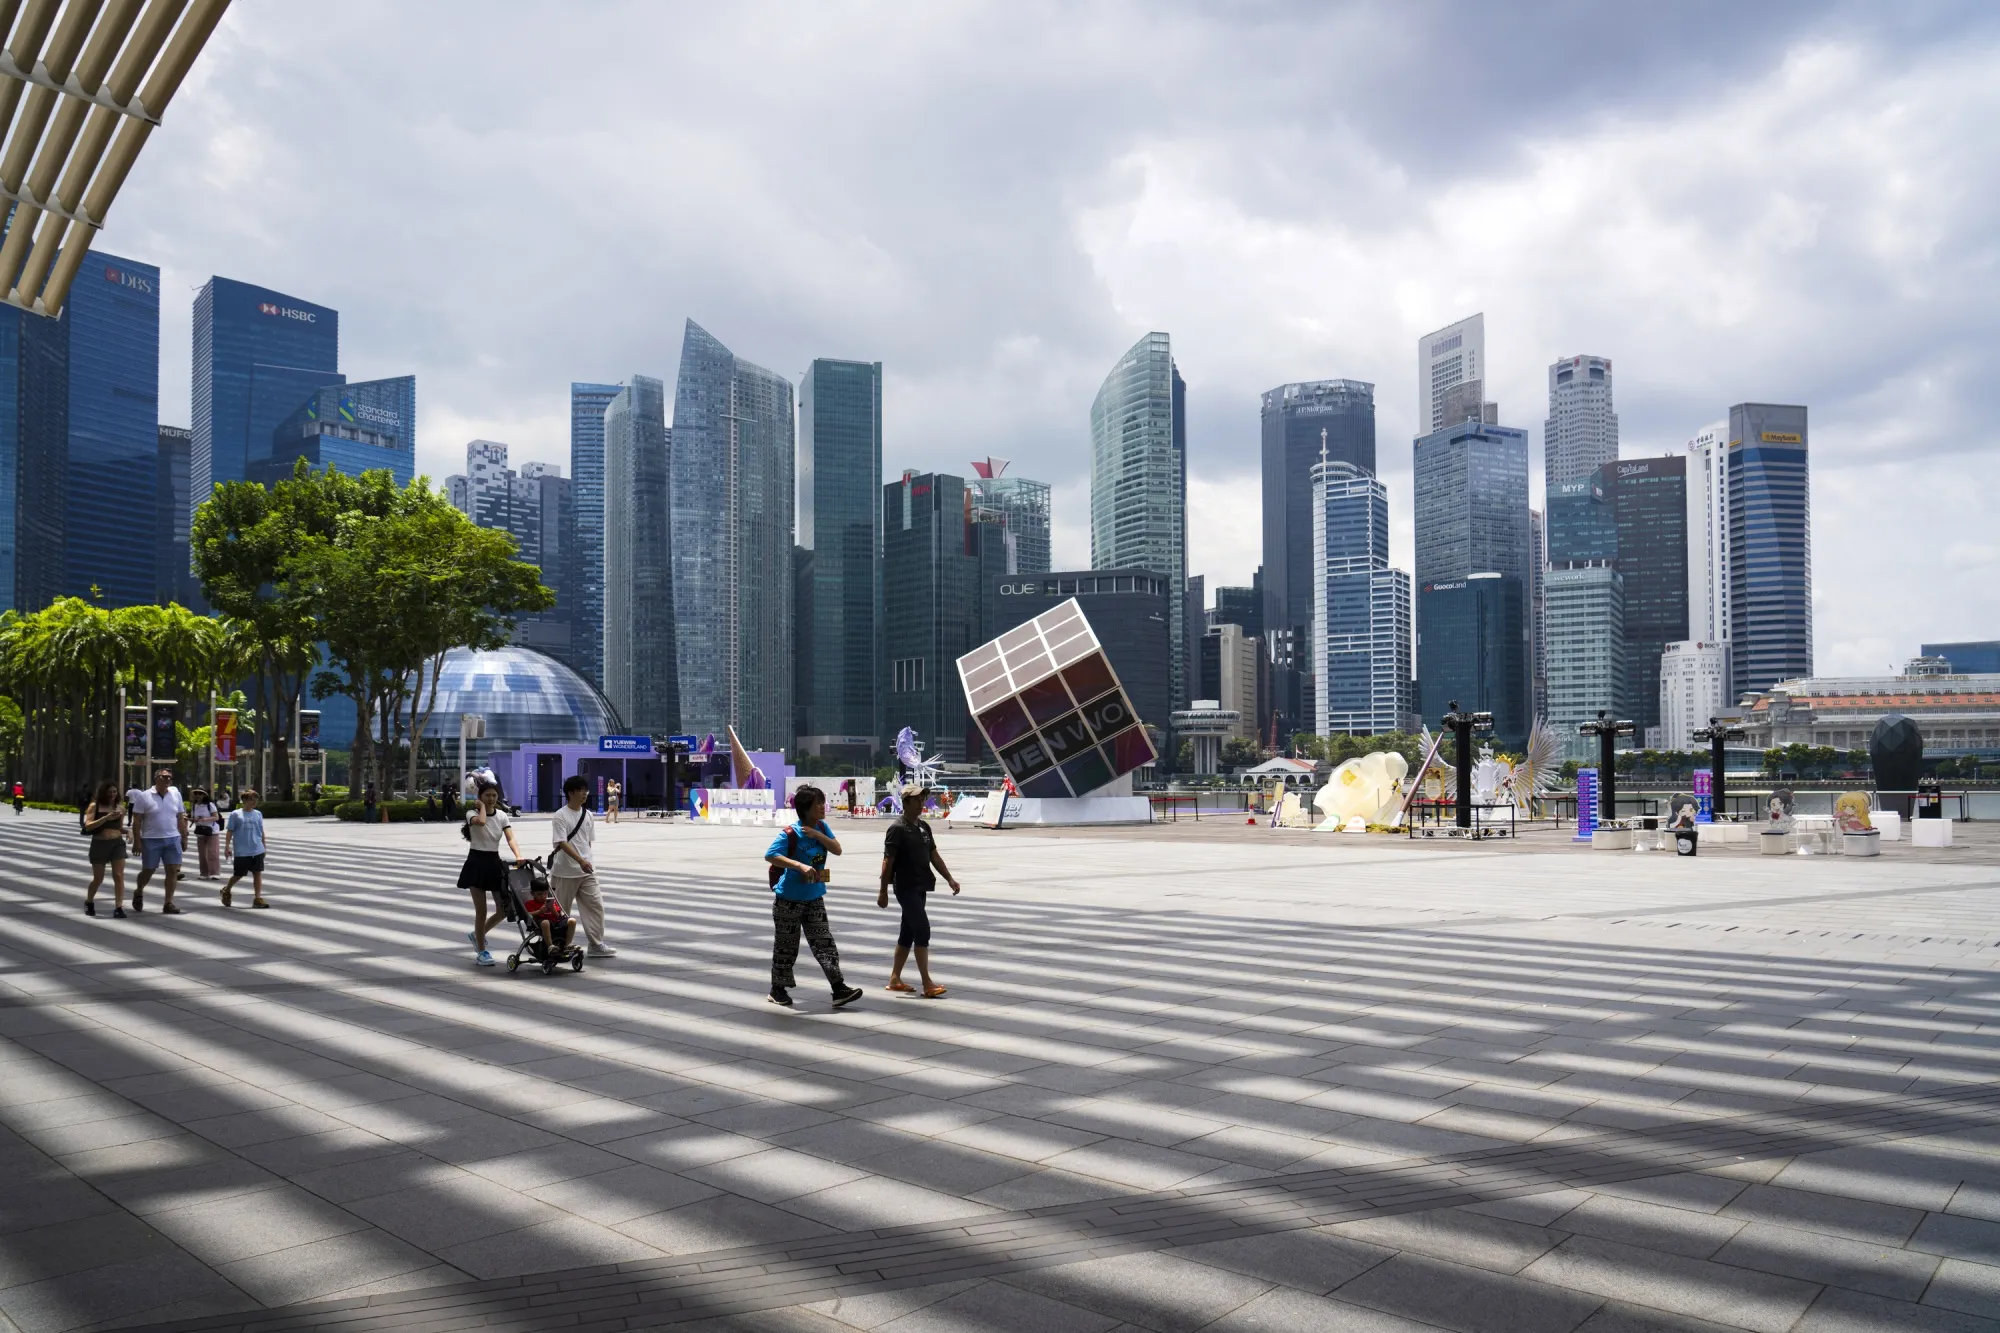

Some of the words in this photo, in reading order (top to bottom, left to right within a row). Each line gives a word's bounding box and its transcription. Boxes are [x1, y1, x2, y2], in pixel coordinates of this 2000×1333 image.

[121, 272, 152, 293] DBS
[281, 308, 317, 323] HSBC
[357, 403, 398, 419] standard
[357, 410, 400, 427] chartered
[159, 427, 192, 440] MUFG
[1770, 433, 1799, 443] Maybank
[482, 448, 503, 461] citi
[1617, 464, 1649, 474] CapitaLand
[1562, 483, 1585, 493] MYP
[1000, 583, 1036, 596] OUE
[1433, 581, 1467, 591] GuocoLand
[1894, 675, 1907, 683] THE
[1947, 674, 1971, 682] HOTEL
